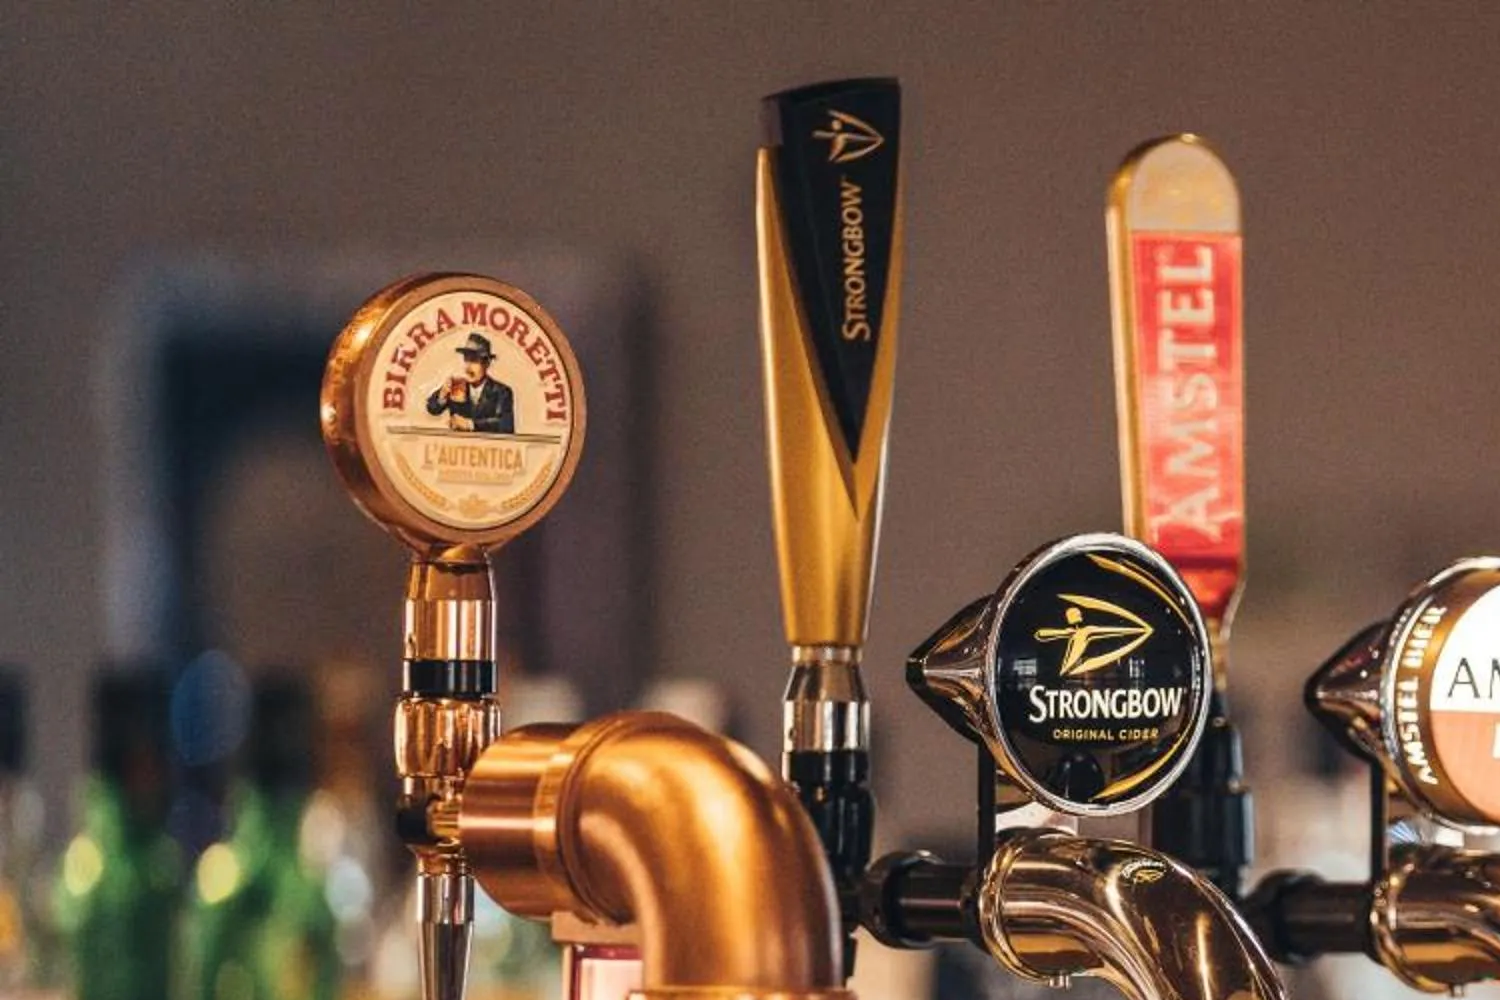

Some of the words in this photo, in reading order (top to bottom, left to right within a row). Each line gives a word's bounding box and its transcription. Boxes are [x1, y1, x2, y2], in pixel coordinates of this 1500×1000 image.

[840, 180, 871, 342] STRONGBOW
[383, 307, 456, 411] BIRRA
[461, 301, 567, 422] MORETTI
[1156, 244, 1221, 543] AMSTEL
[424, 443, 523, 470] L'AUTENTICA
[1028, 684, 1183, 723] STRONGBOW
[1053, 728, 1114, 741] ORIGINAL
[1118, 729, 1160, 740] CIDER
[1397, 676, 1439, 786] AMSTEL
